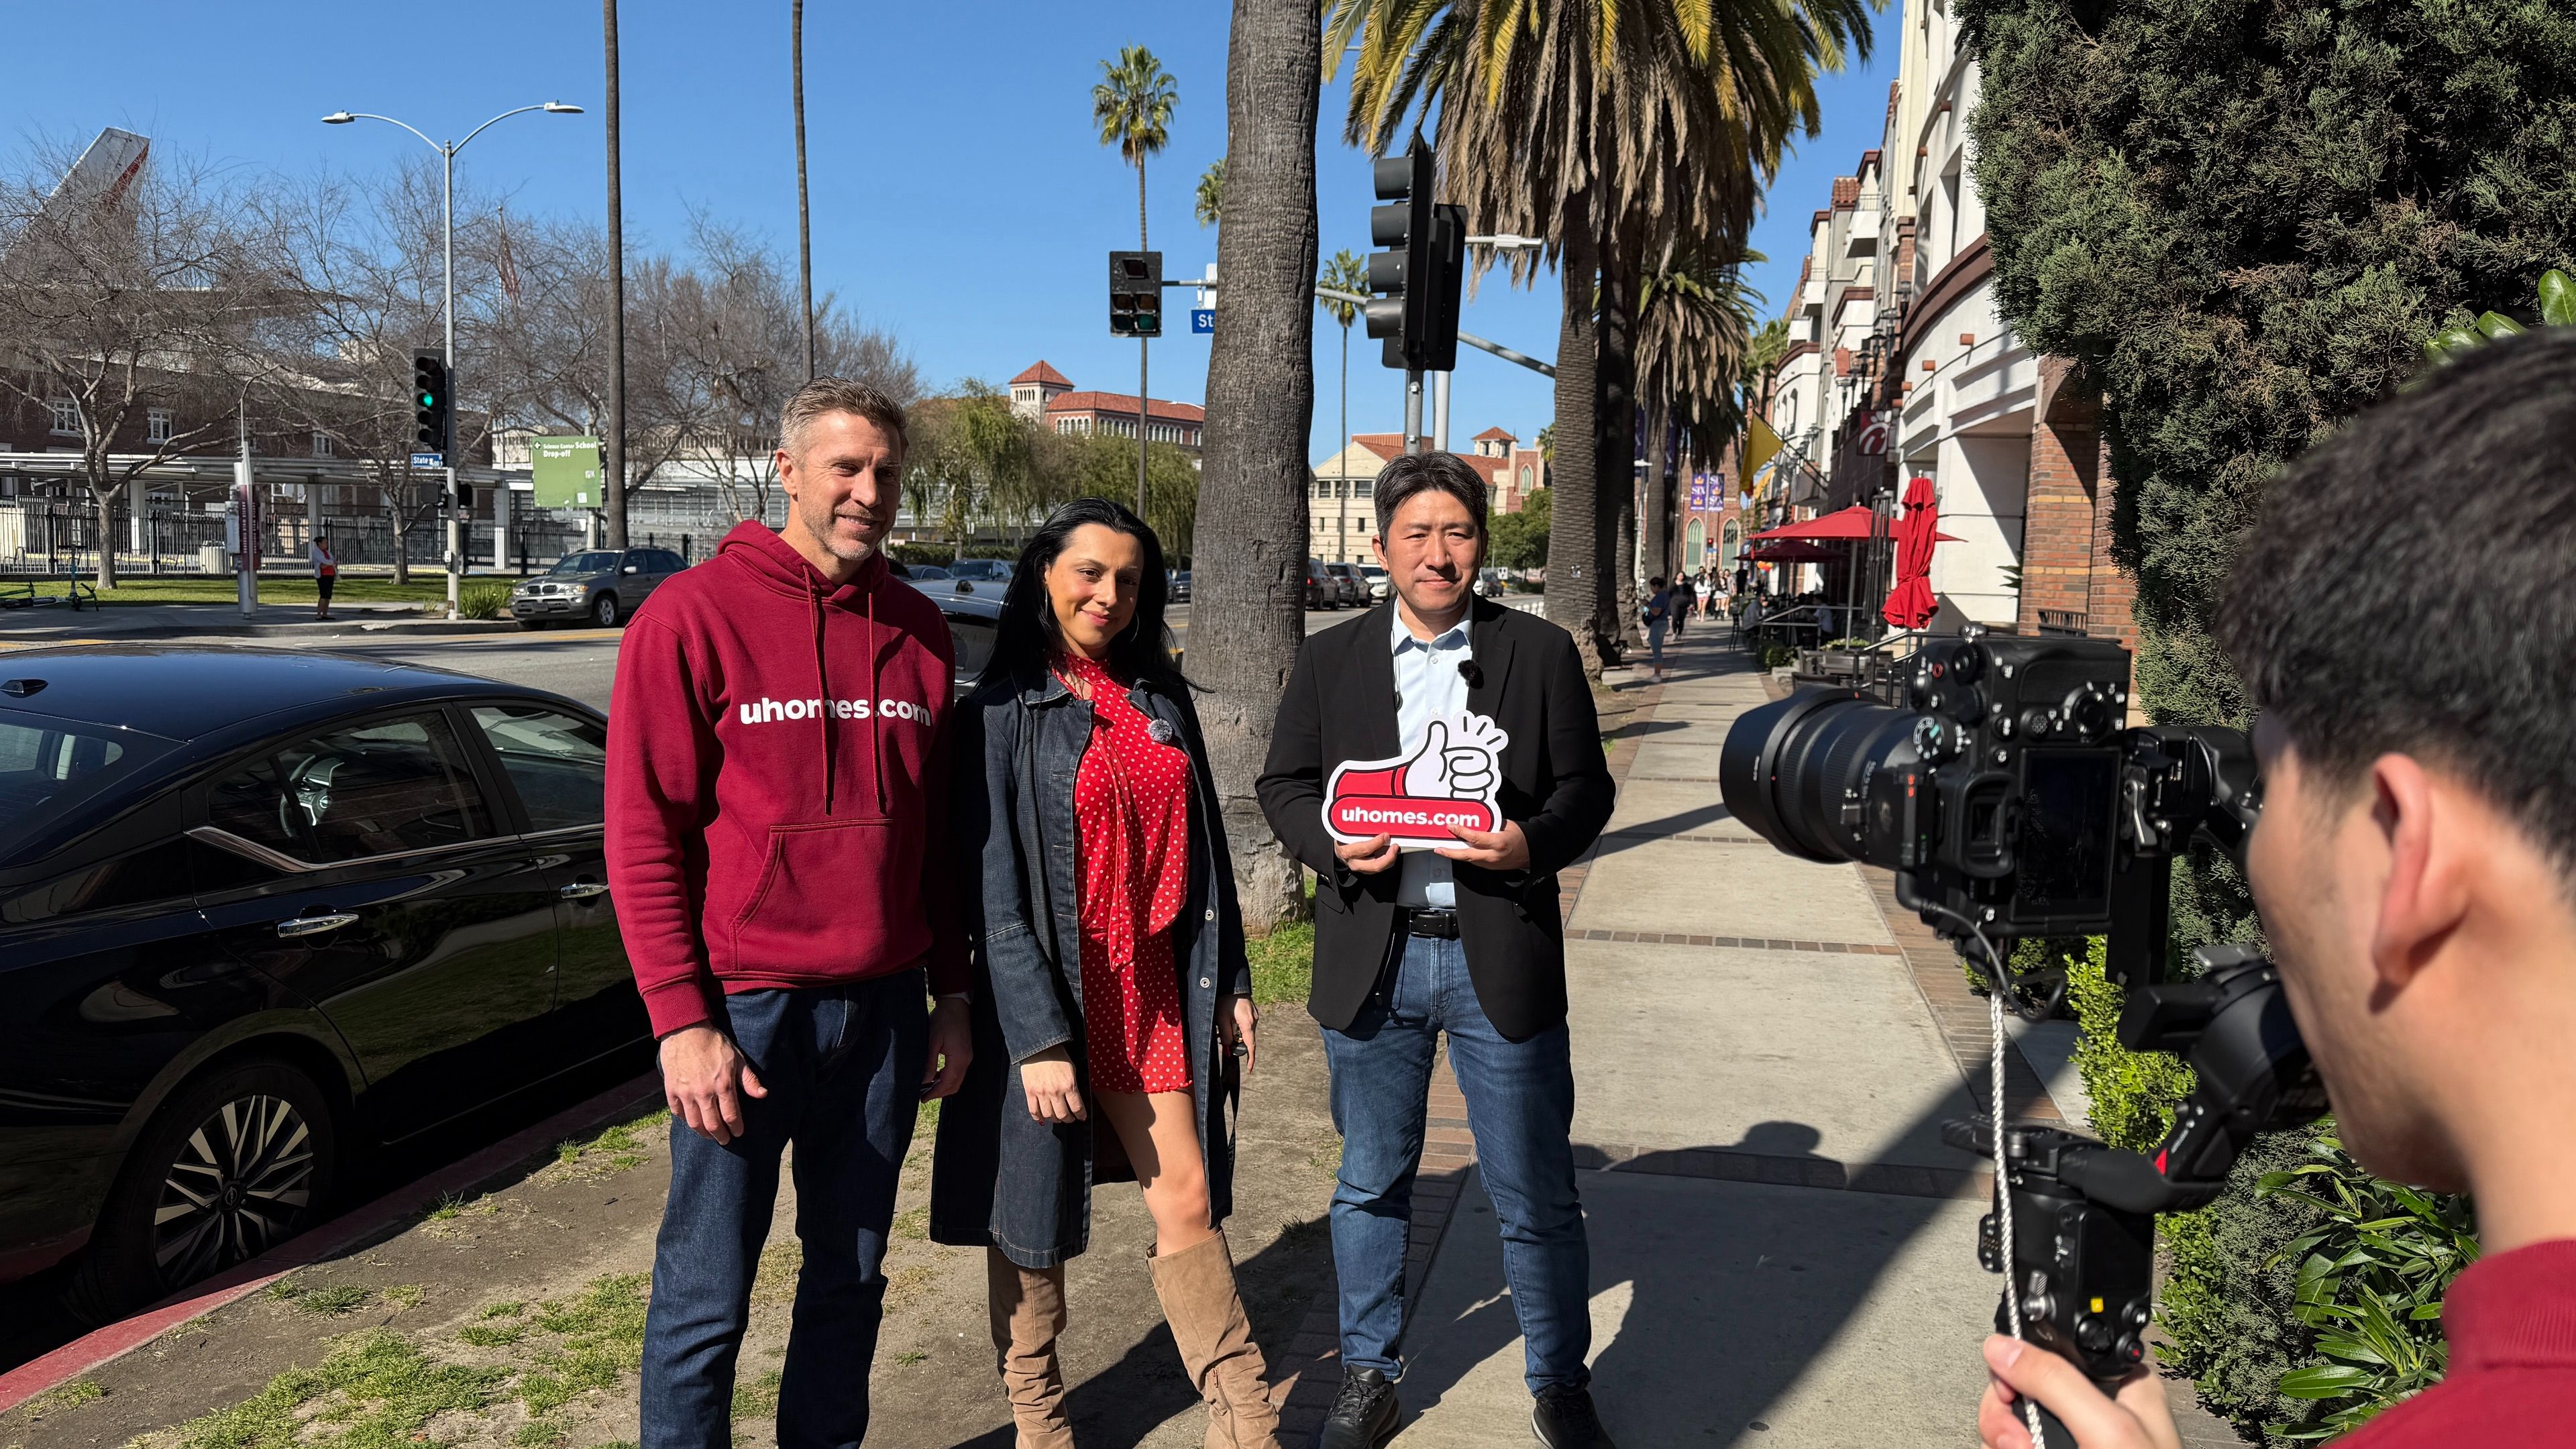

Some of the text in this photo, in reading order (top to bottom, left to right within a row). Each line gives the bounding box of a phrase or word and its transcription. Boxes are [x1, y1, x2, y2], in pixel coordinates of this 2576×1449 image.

[1197, 313, 1216, 328] St
[575, 441, 597, 449] School
[413, 455, 429, 464] State
[543, 449, 571, 459] Drop-off
[740, 697, 931, 727] uhomes.com
[1342, 806, 1480, 827] uhomes.com
